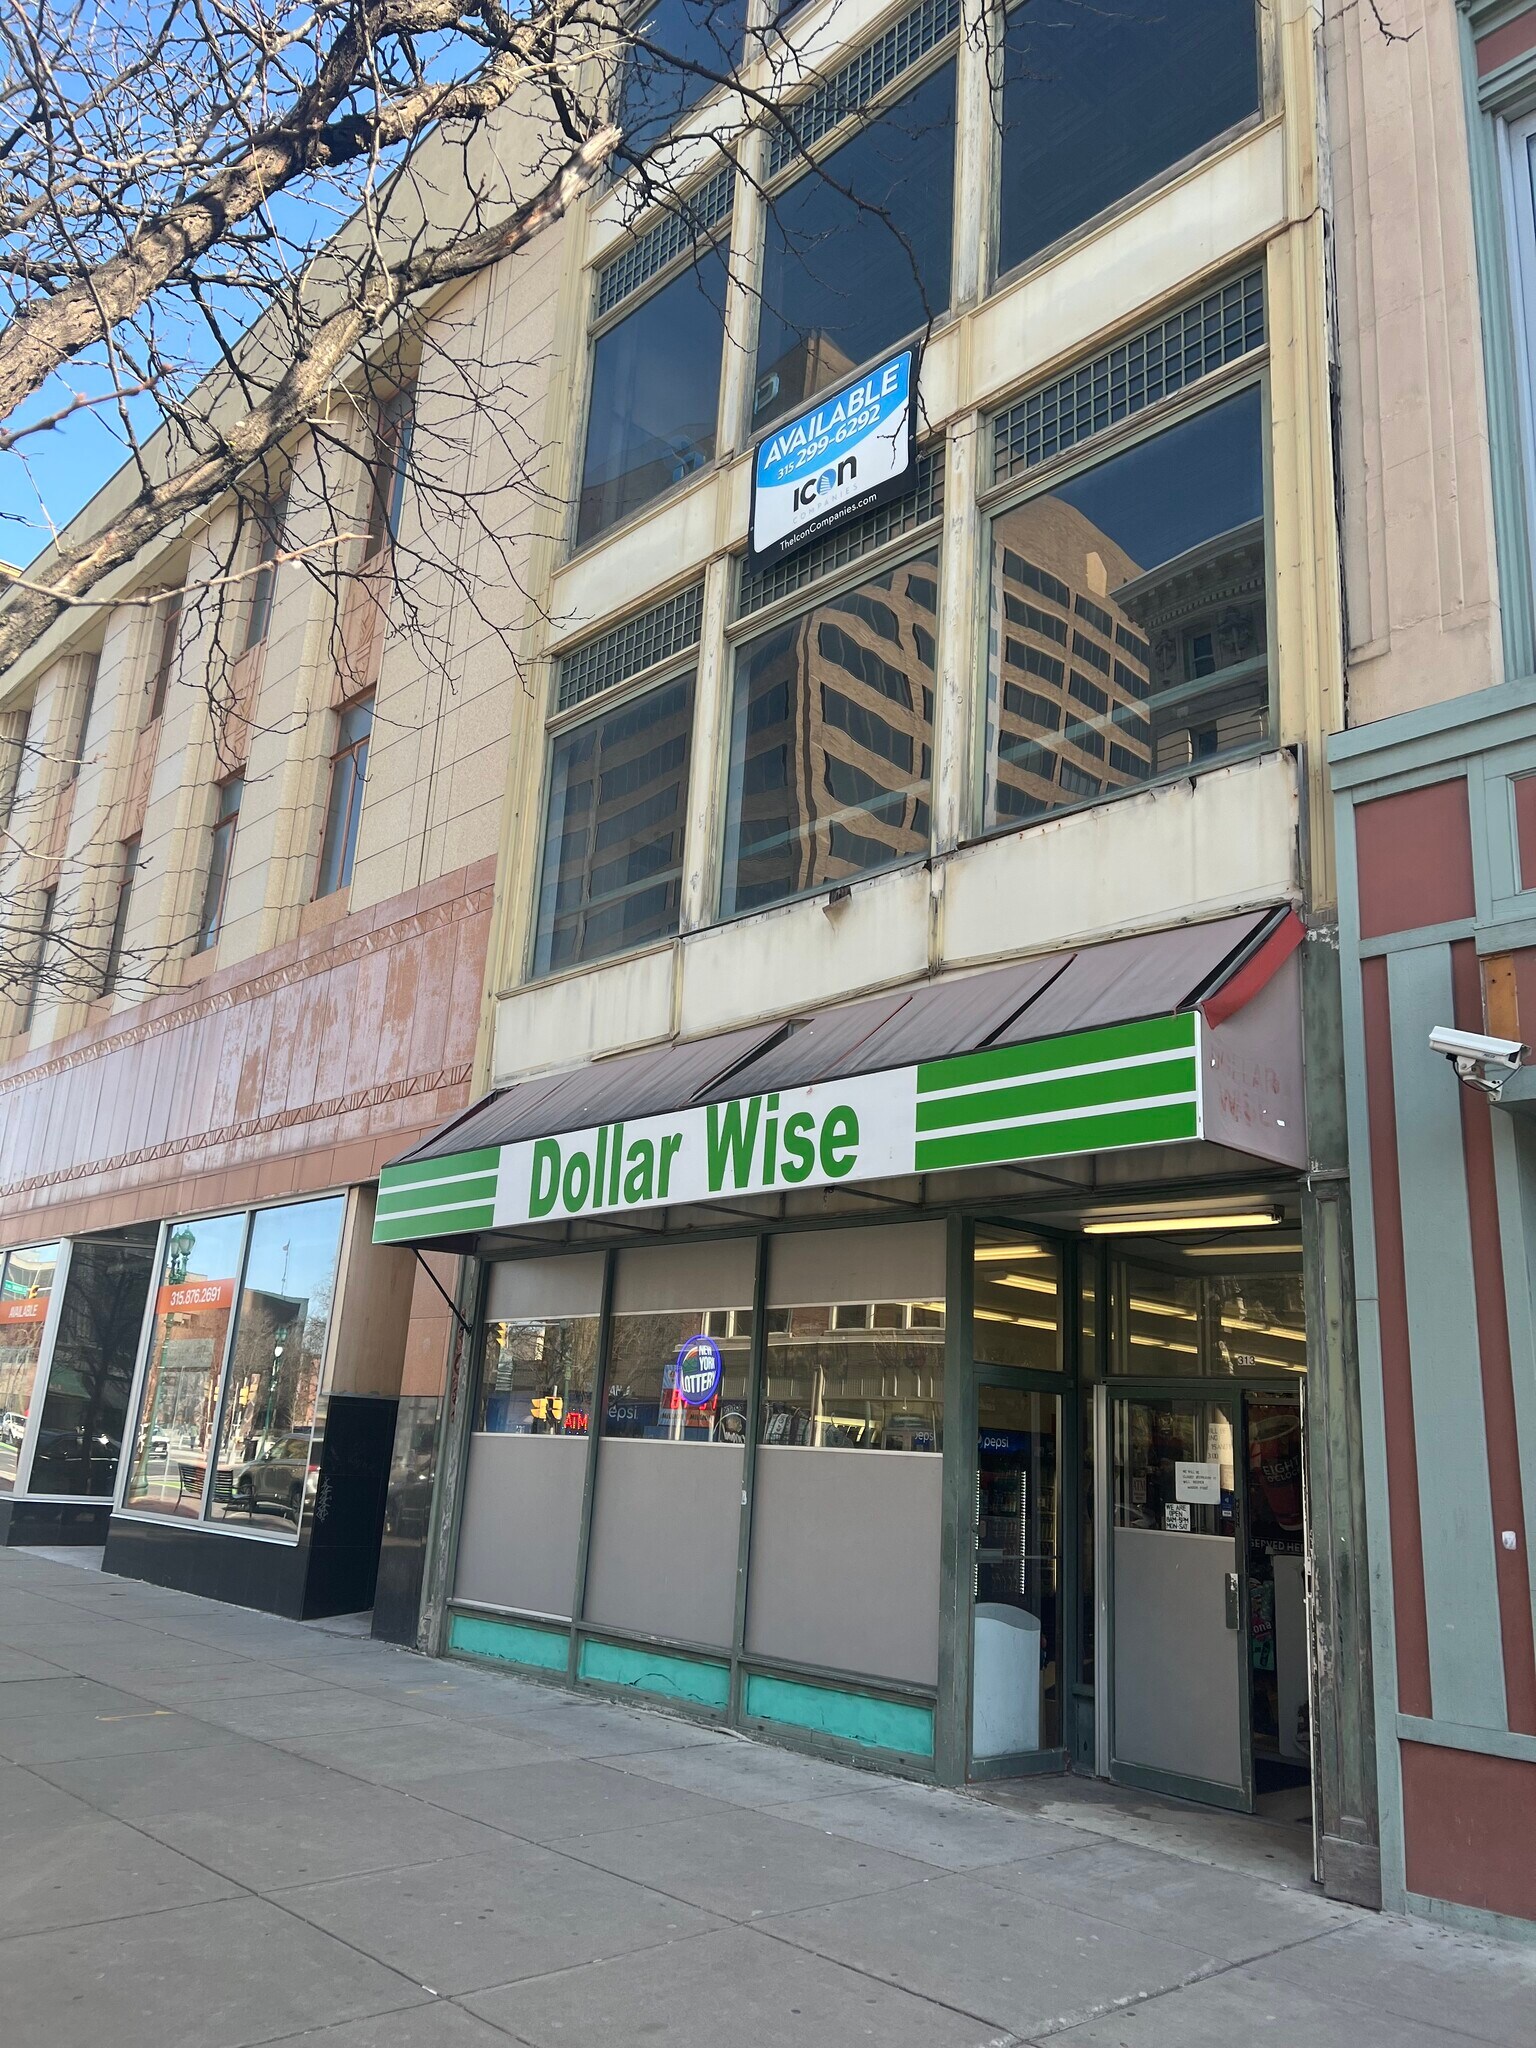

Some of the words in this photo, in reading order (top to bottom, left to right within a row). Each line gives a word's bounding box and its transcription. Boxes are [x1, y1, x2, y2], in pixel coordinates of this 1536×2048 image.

[764, 363, 900, 470] AVAILABLE
[777, 463, 795, 480] 315
[795, 404, 880, 469] 299-6292
[792, 484, 858, 524] COMPANIES
[779, 492, 877, 551] TheIconCompanies.com
[528, 1122, 683, 1220] Dollar
[705, 1092, 860, 1193] Wise
[170, 1286, 222, 1306] 315.876.2691
[699, 1345, 712, 1356] NEW
[1237, 1355, 1255, 1365] 313
[699, 1356, 716, 1371] YORK
[563, 1412, 589, 1430] ATM
[608, 1405, 637, 1421] epsi
[984, 1436, 1009, 1449] pepsi
[1262, 1455, 1298, 1475] EIGHT
